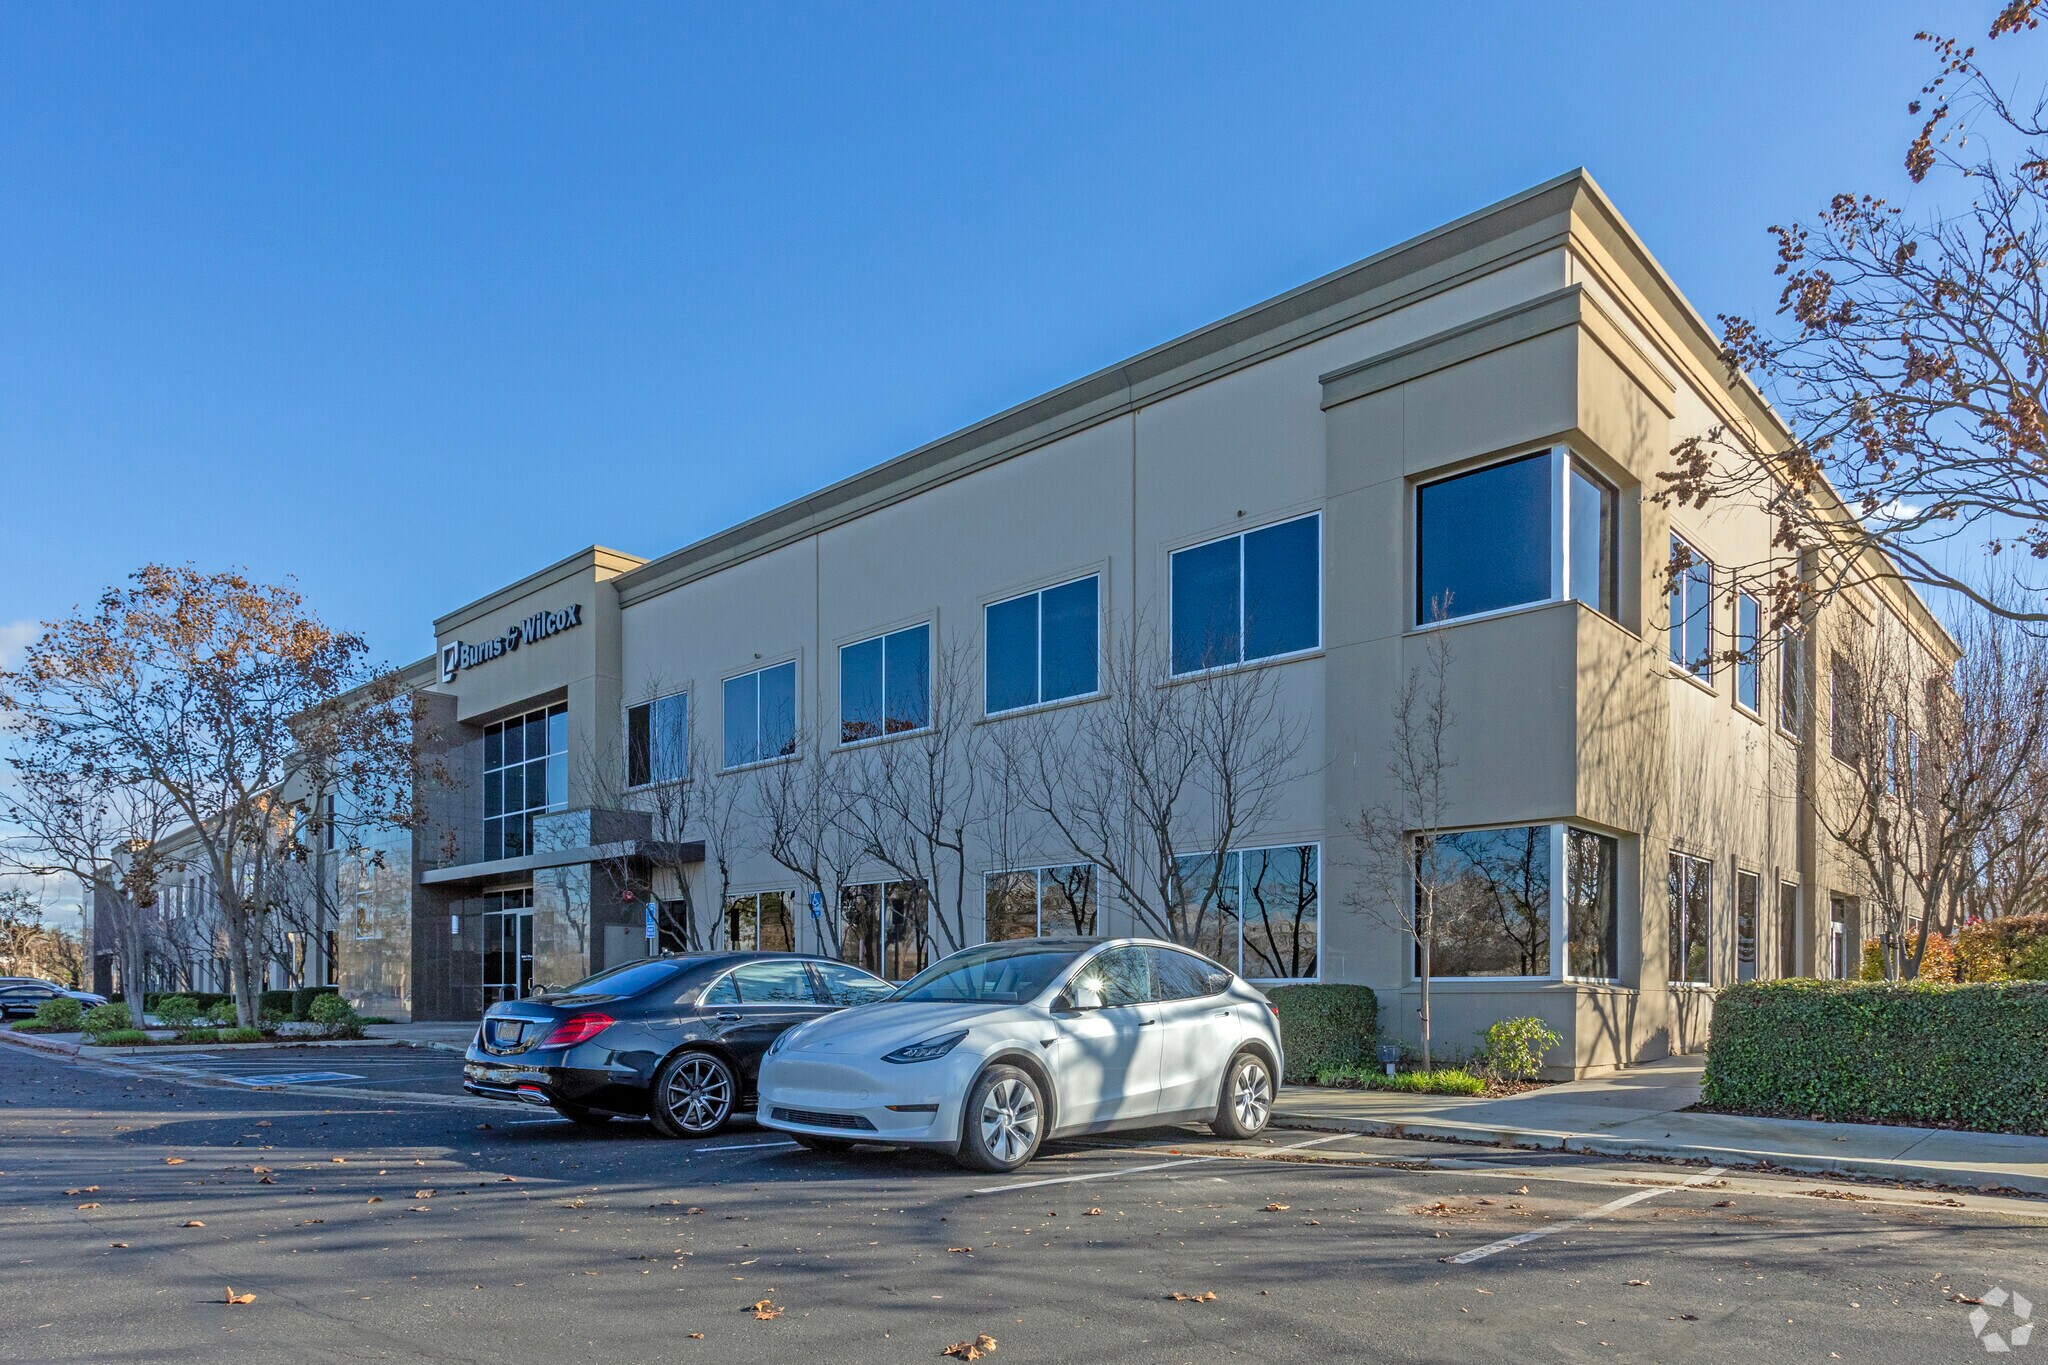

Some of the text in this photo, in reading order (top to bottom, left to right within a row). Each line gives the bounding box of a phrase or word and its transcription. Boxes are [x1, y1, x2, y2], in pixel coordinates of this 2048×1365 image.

[460, 603, 580, 670] Burns & Wilcox
